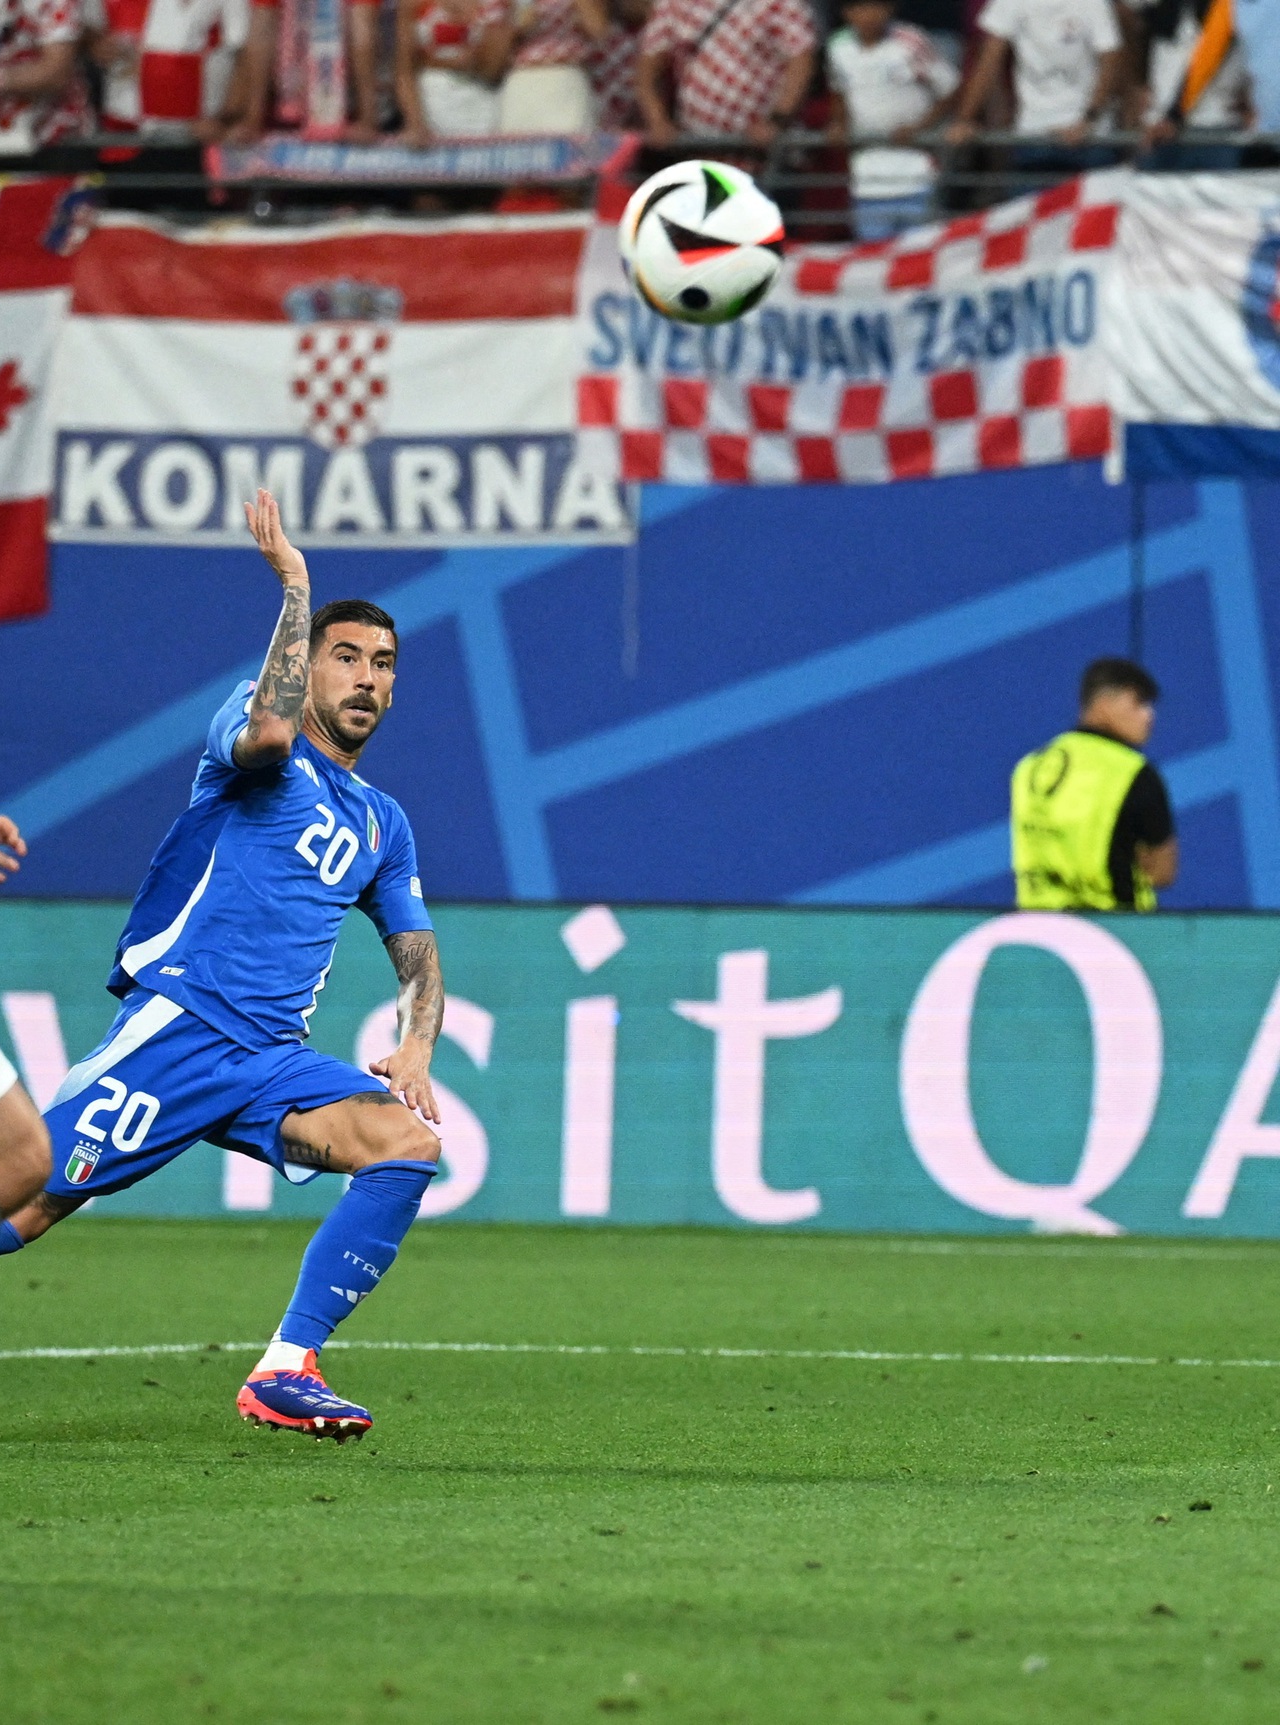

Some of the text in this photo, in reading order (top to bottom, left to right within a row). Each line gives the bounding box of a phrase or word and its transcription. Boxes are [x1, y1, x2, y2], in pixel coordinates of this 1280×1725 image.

[61, 440, 630, 532] KOMARNA
[294, 803, 359, 885] 20
[74, 1076, 160, 1152] 20
[75, 1148, 96, 1163] ITALIA
